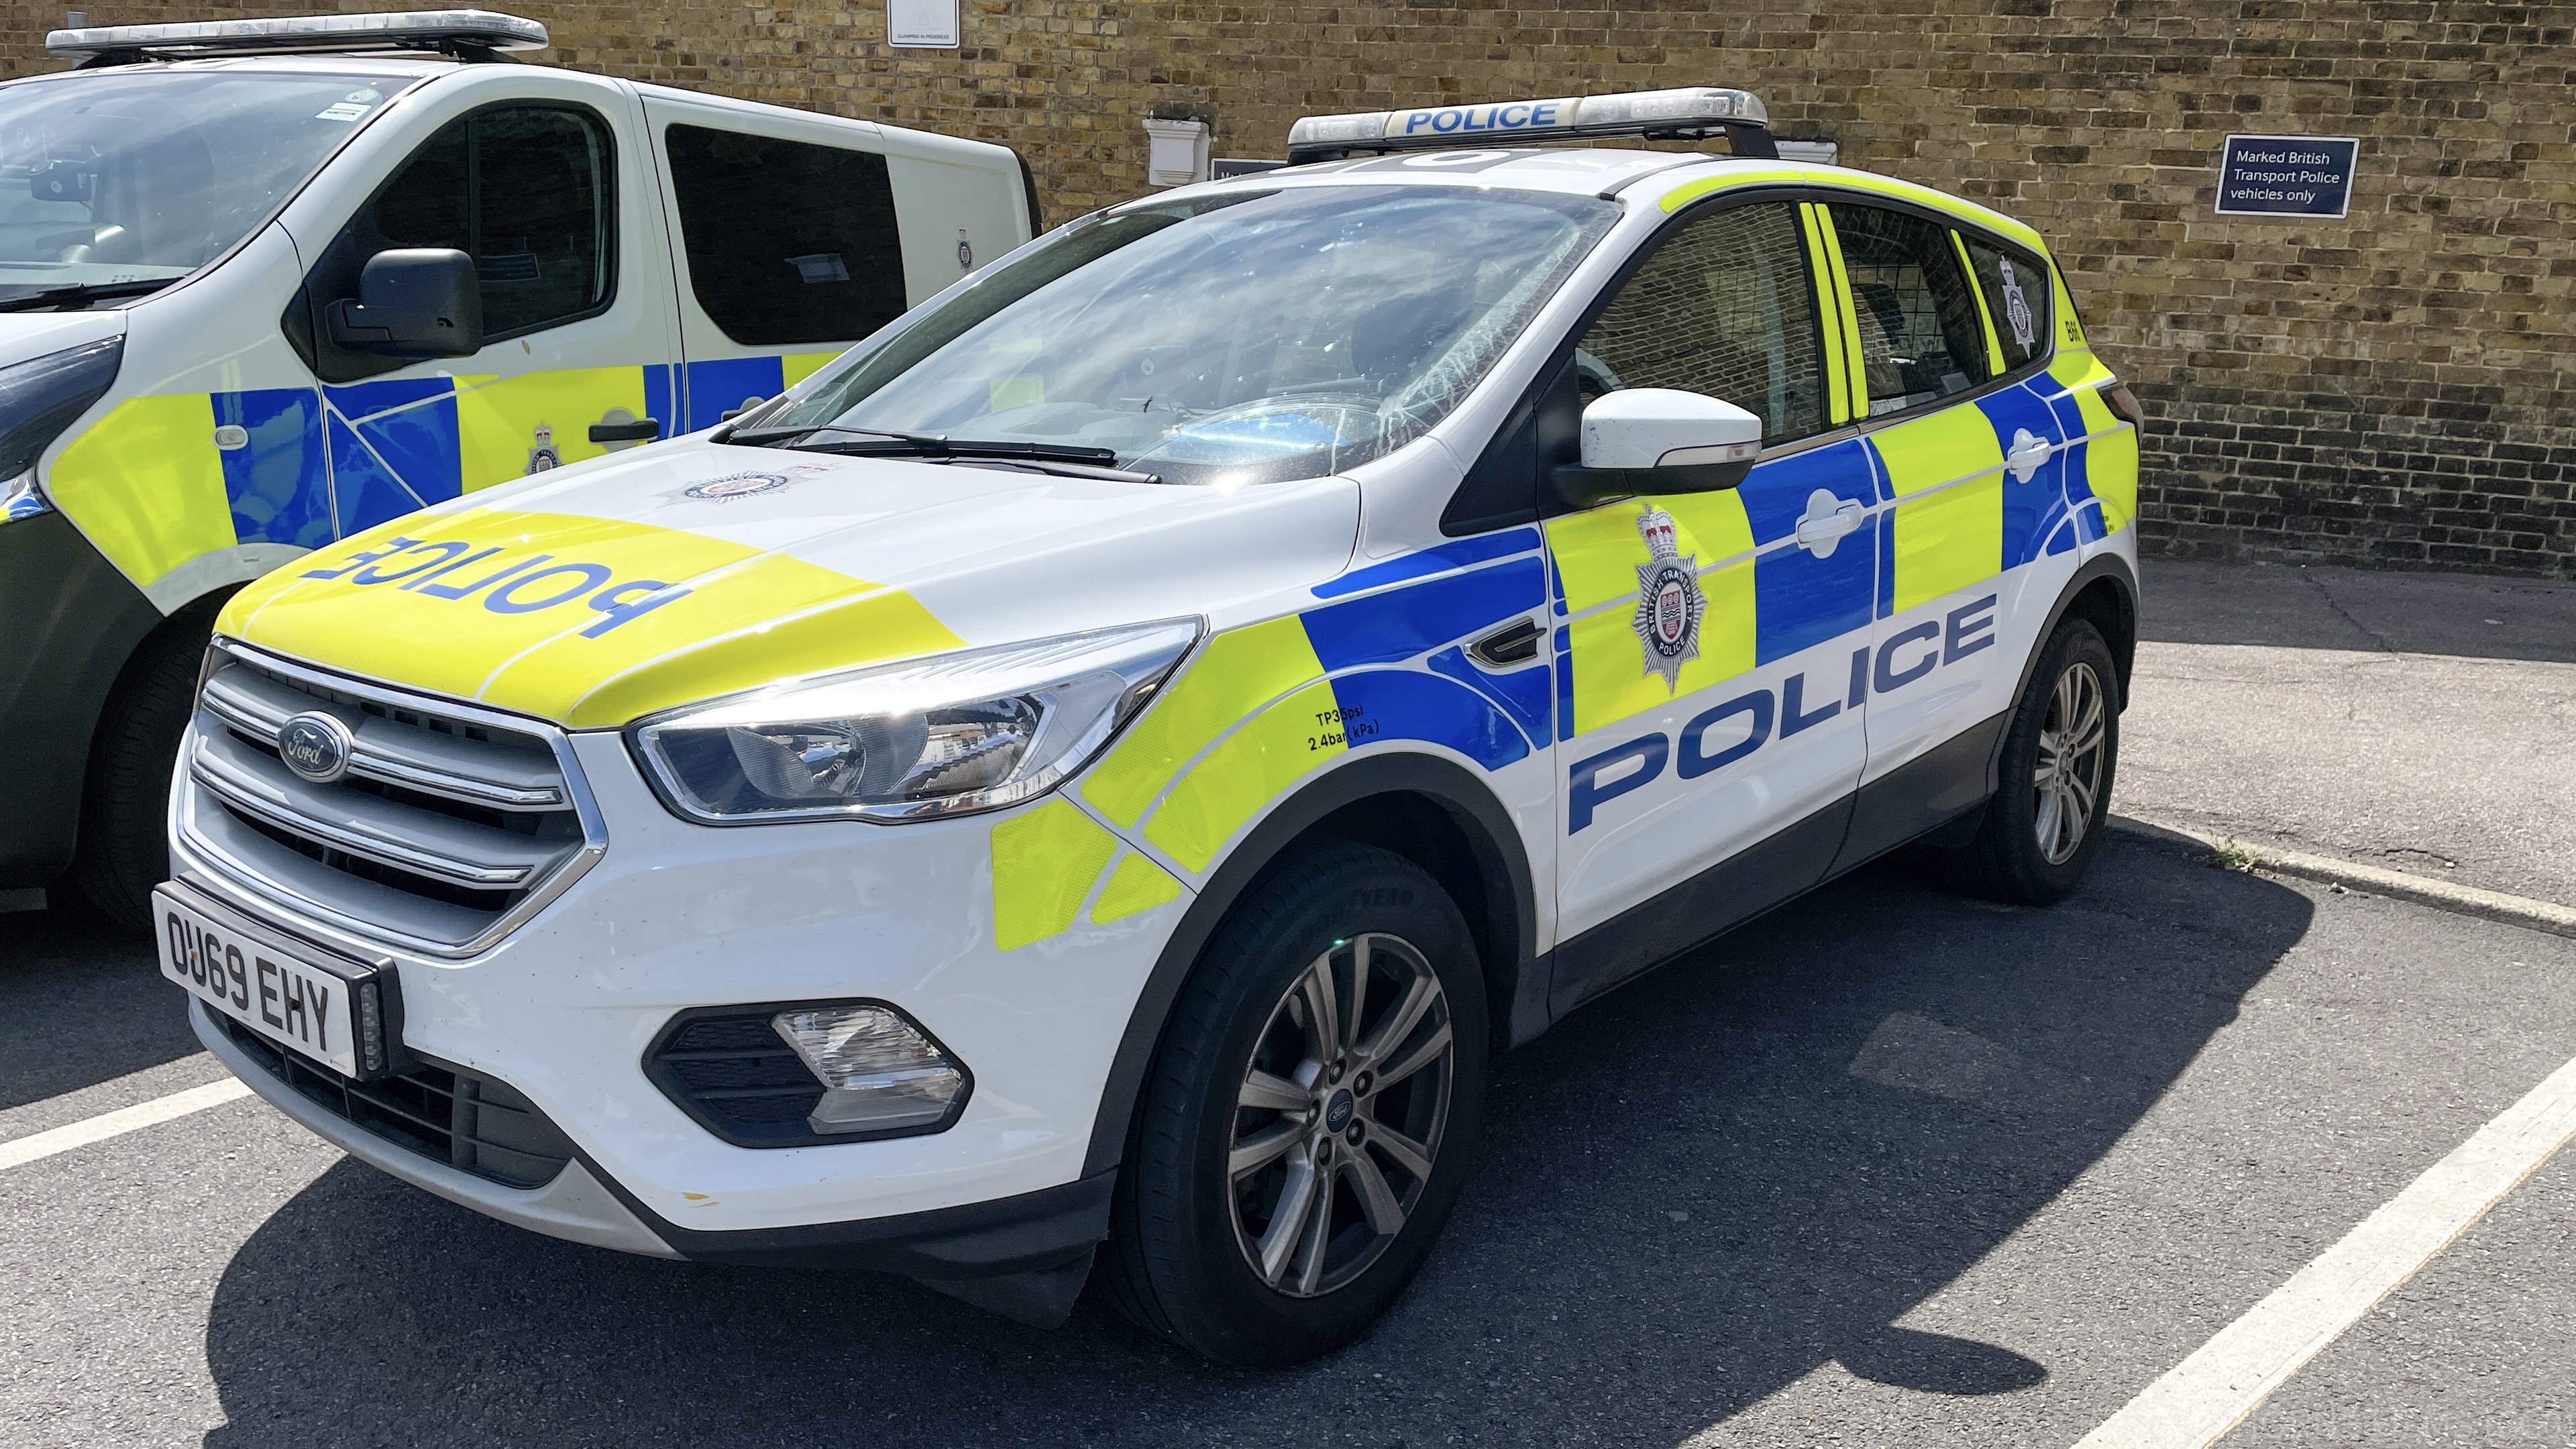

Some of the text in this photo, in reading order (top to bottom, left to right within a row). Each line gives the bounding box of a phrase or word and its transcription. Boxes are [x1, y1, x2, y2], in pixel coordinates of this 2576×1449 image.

[1406, 103, 1560, 134] POLICE
[2236, 150, 2330, 165] Marked British
[2234, 168, 2341, 184] Transport Police
[2231, 188, 2316, 204] vehicles only
[1649, 570, 1693, 634] BRITISH TRANSPORT
[1658, 636, 1686, 656] POLICE
[1568, 593, 1996, 836] POLICE
[288, 728, 323, 765] Ford
[167, 911, 329, 1052] OU69 EHY
